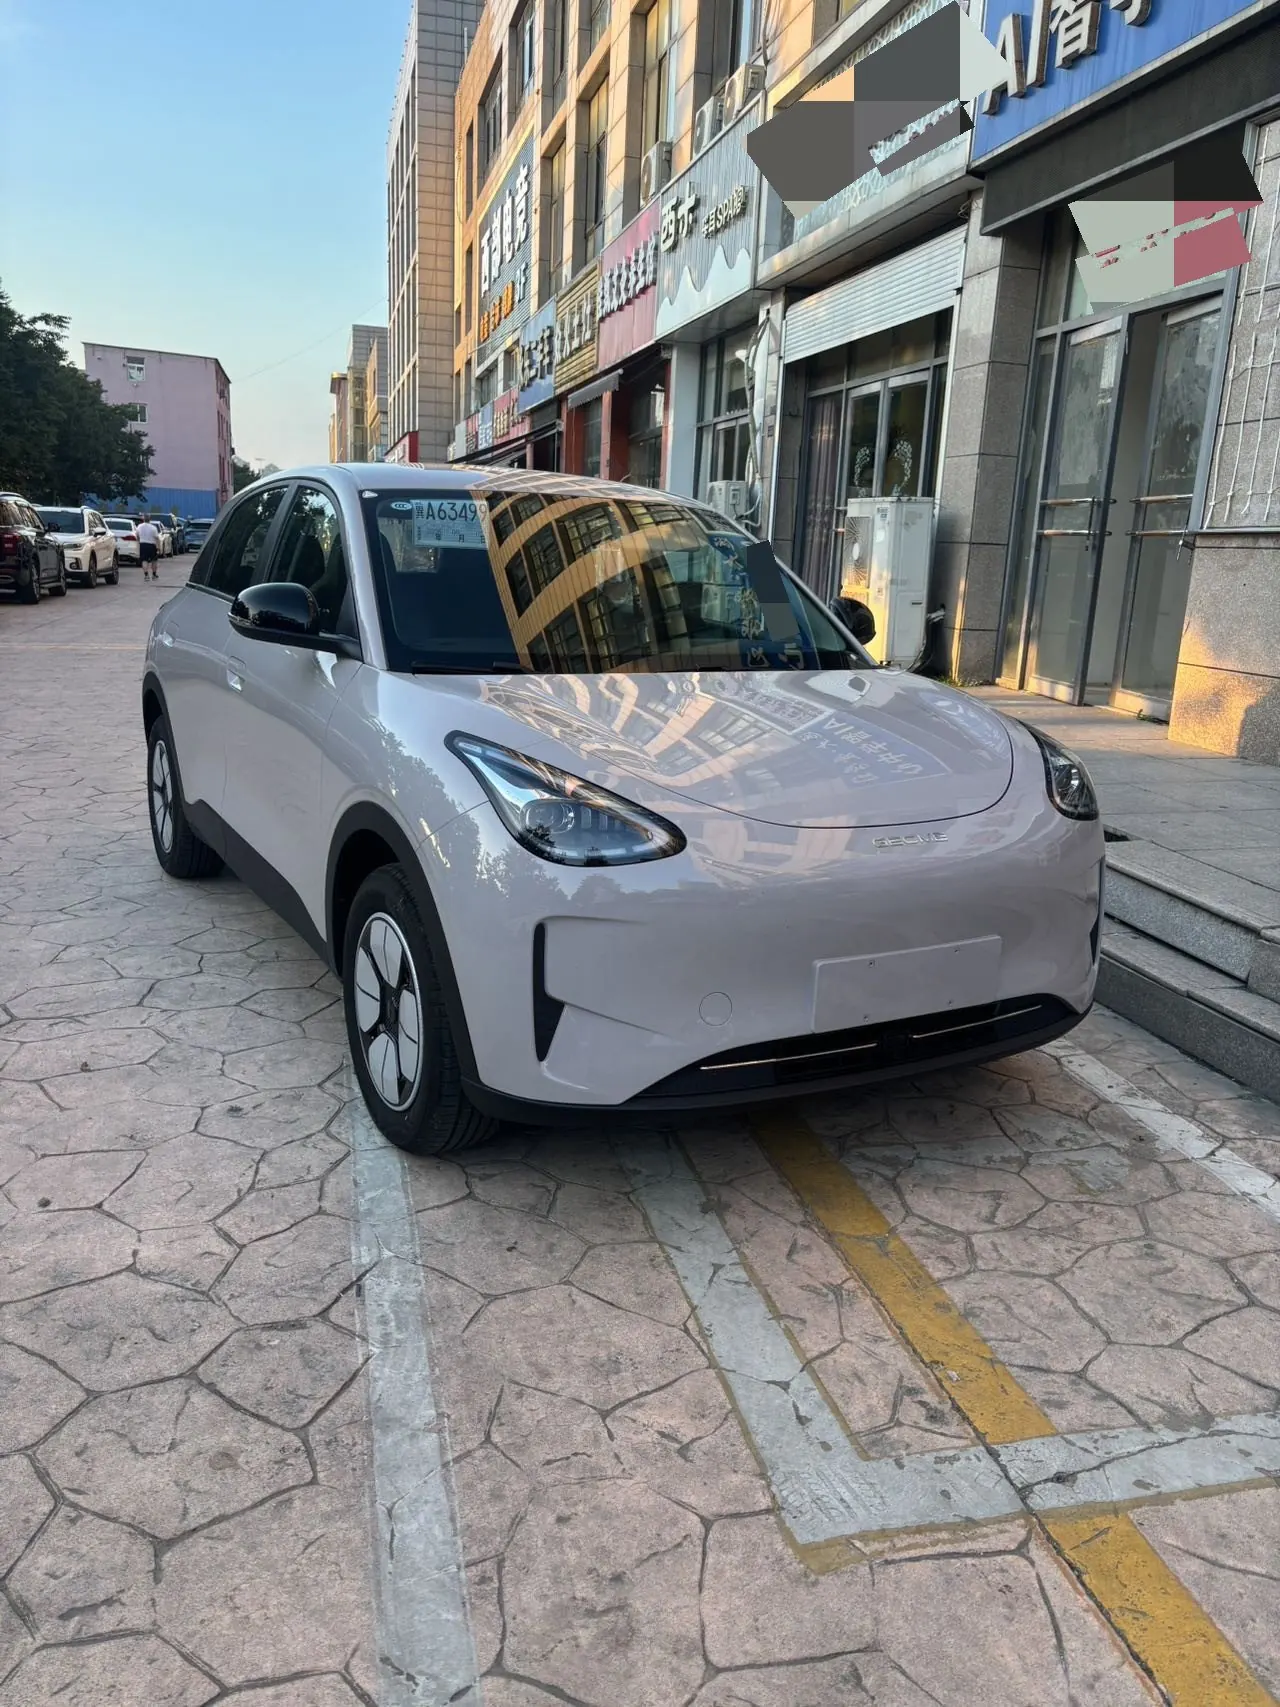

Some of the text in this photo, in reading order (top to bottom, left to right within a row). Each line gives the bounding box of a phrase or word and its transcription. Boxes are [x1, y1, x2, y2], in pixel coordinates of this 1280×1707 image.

[481, 163, 529, 298] 西部电竞
[415, 501, 488, 521] 冀A63499
